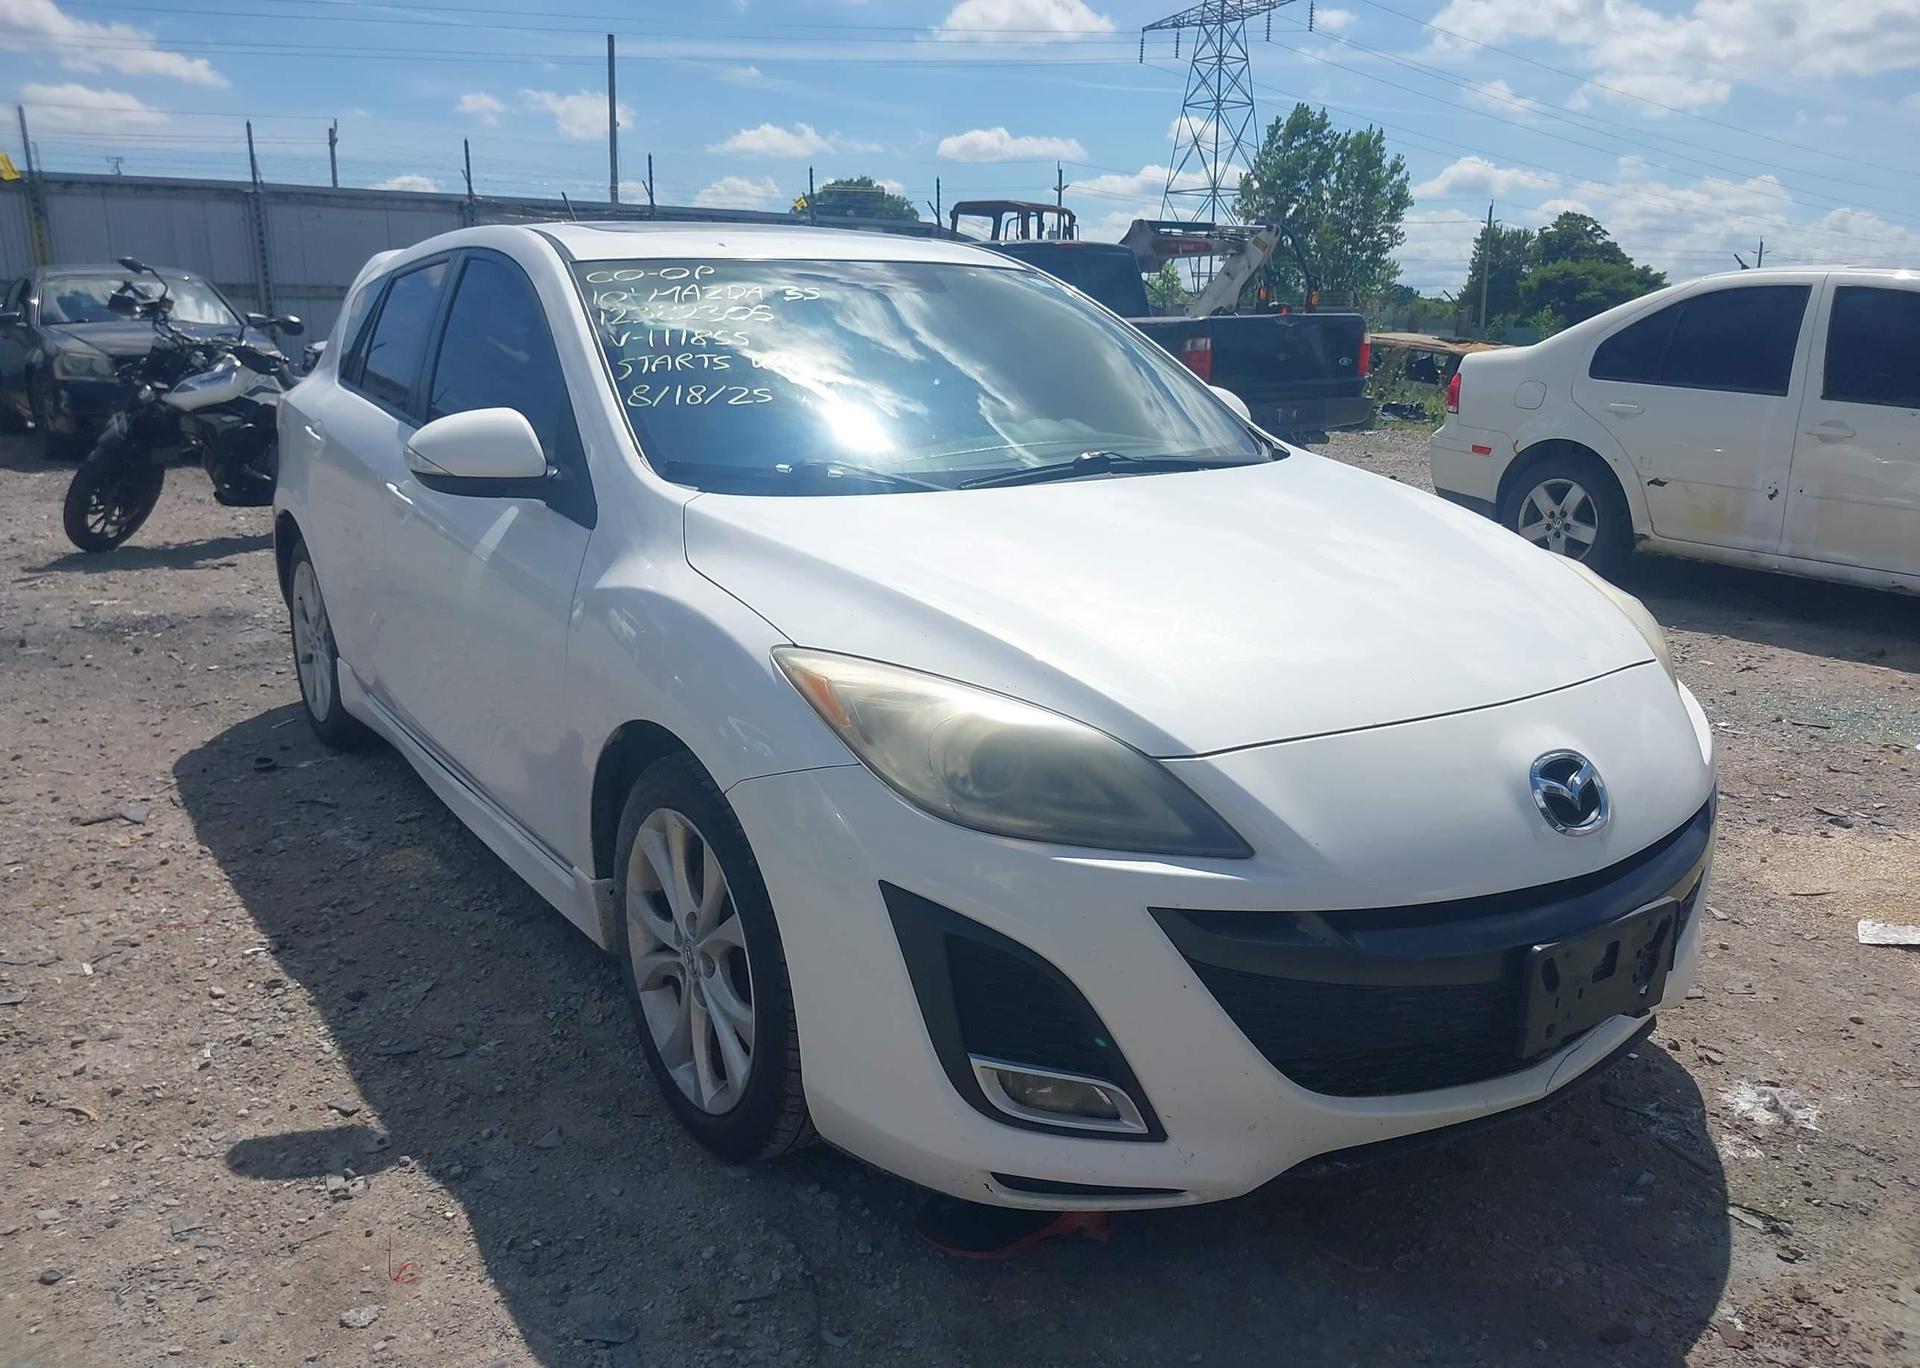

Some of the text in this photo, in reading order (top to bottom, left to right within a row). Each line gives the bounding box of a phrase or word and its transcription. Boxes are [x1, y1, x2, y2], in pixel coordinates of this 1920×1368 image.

[586, 265, 715, 284] CO-OP
[648, 284, 764, 304] MAZDA
[617, 352, 733, 380] STARTS
[627, 384, 774, 407] 8/18/25
